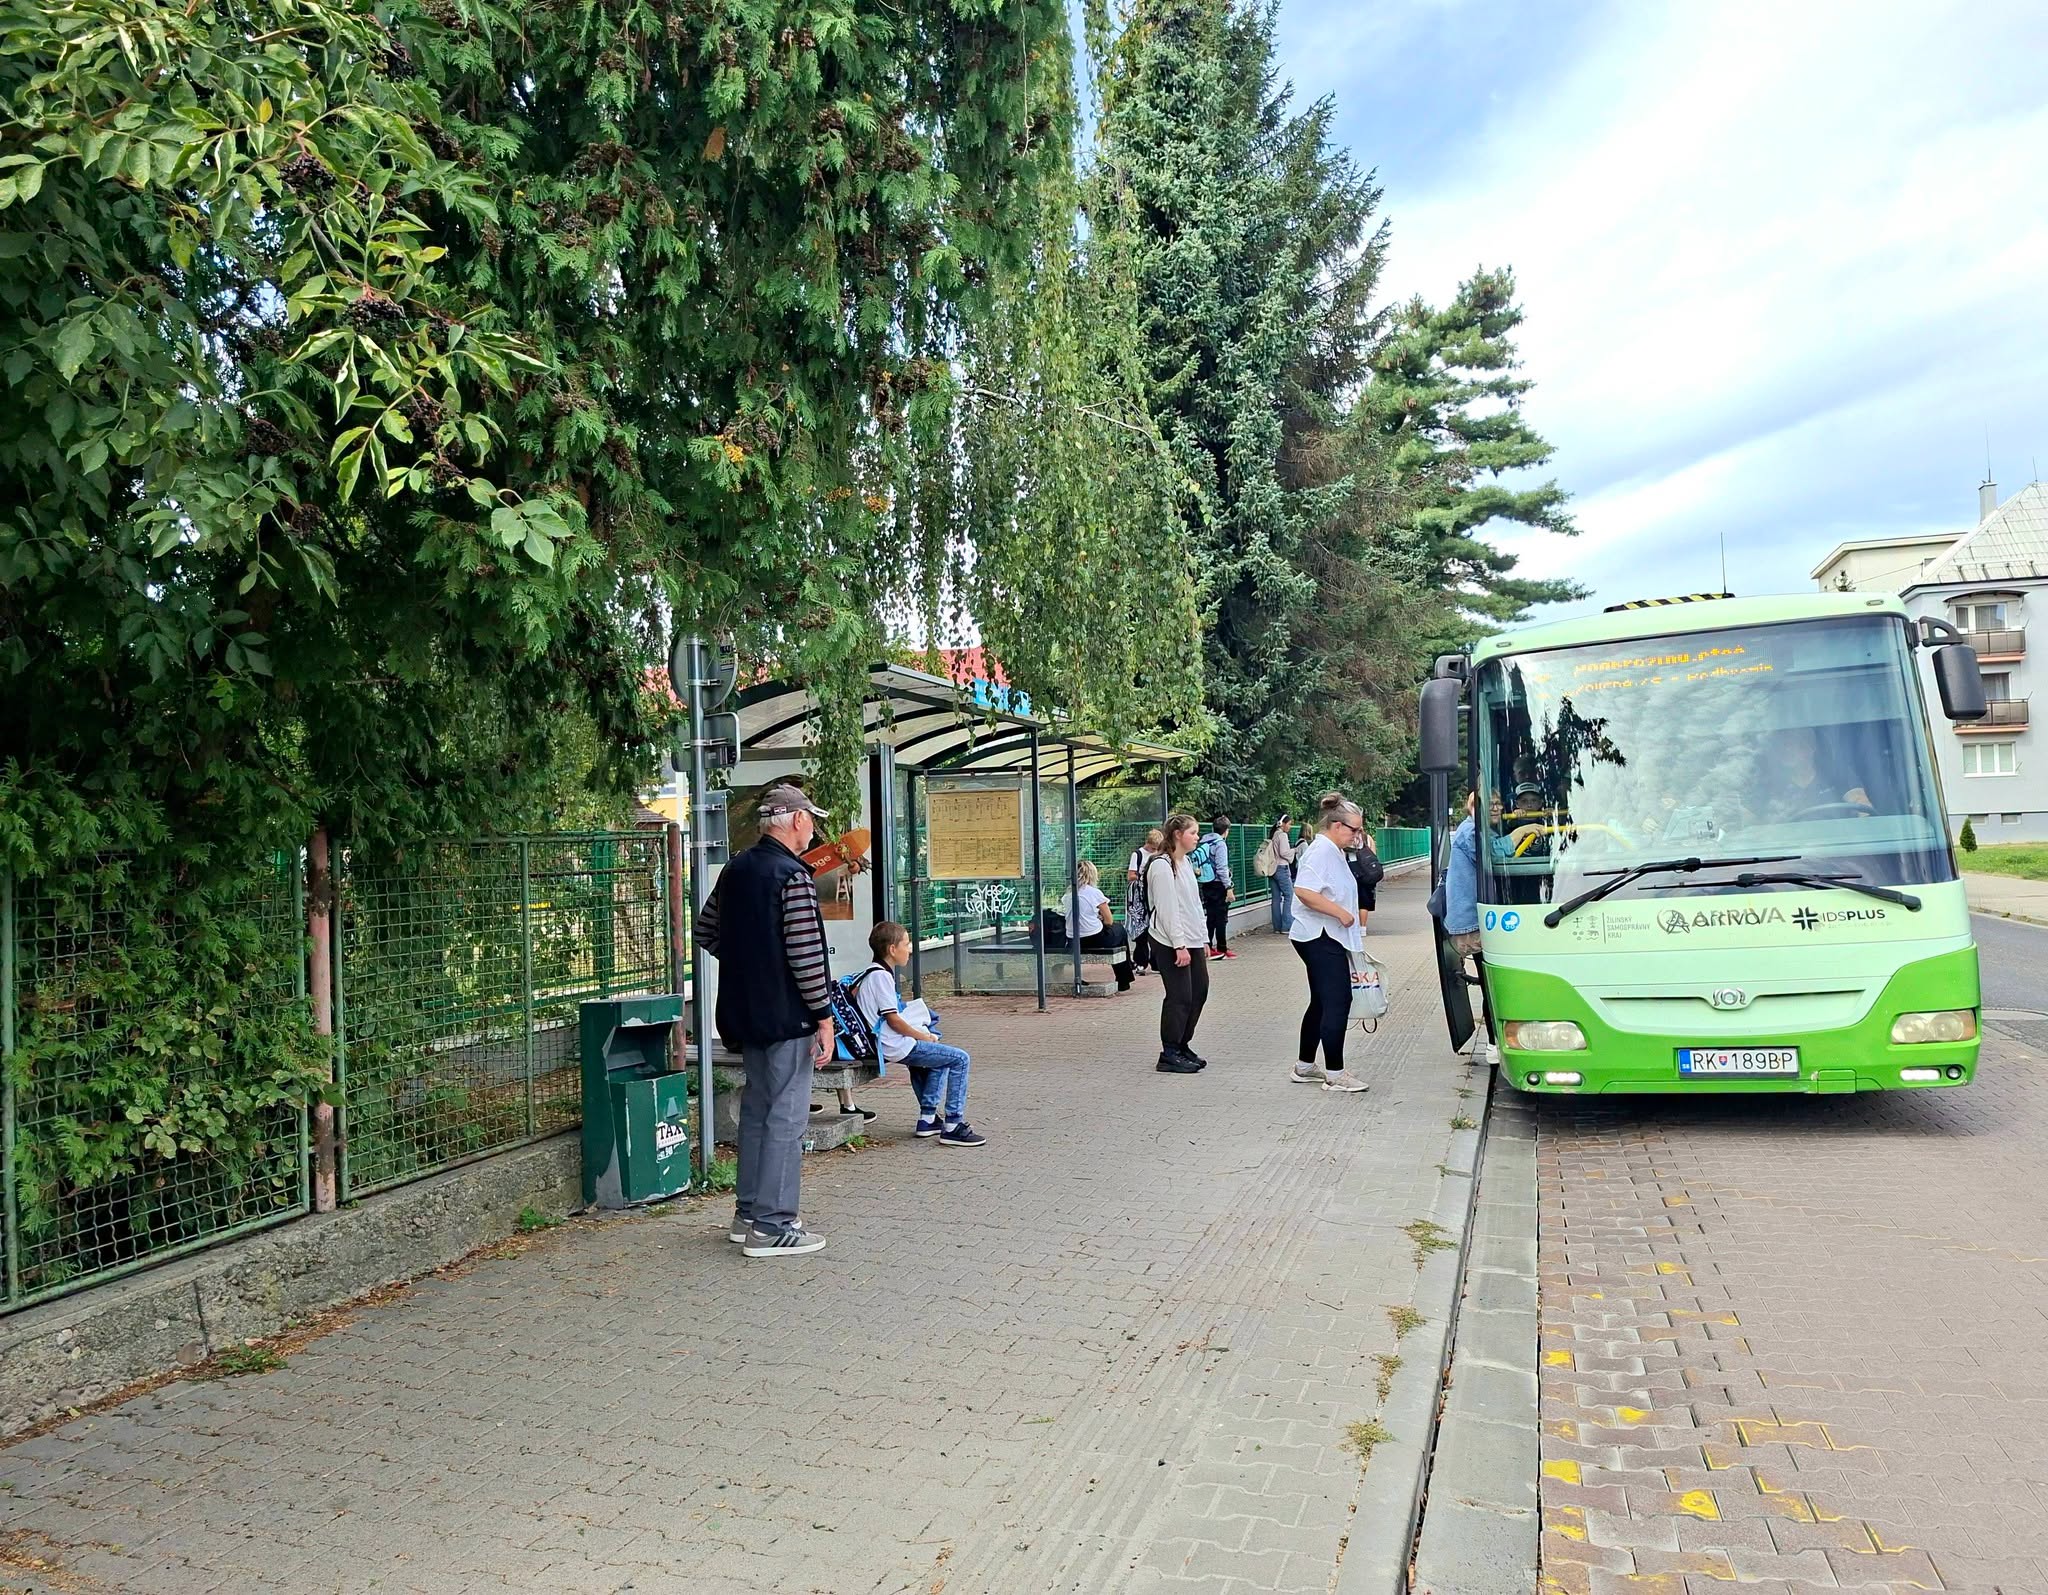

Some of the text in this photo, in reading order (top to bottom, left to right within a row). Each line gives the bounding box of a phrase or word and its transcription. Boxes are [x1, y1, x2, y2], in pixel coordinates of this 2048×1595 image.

[1822, 909, 1886, 922] IDSPLUS
[1693, 1053, 1718, 1071] RK
[1731, 1052, 1793, 1071] 189BP
